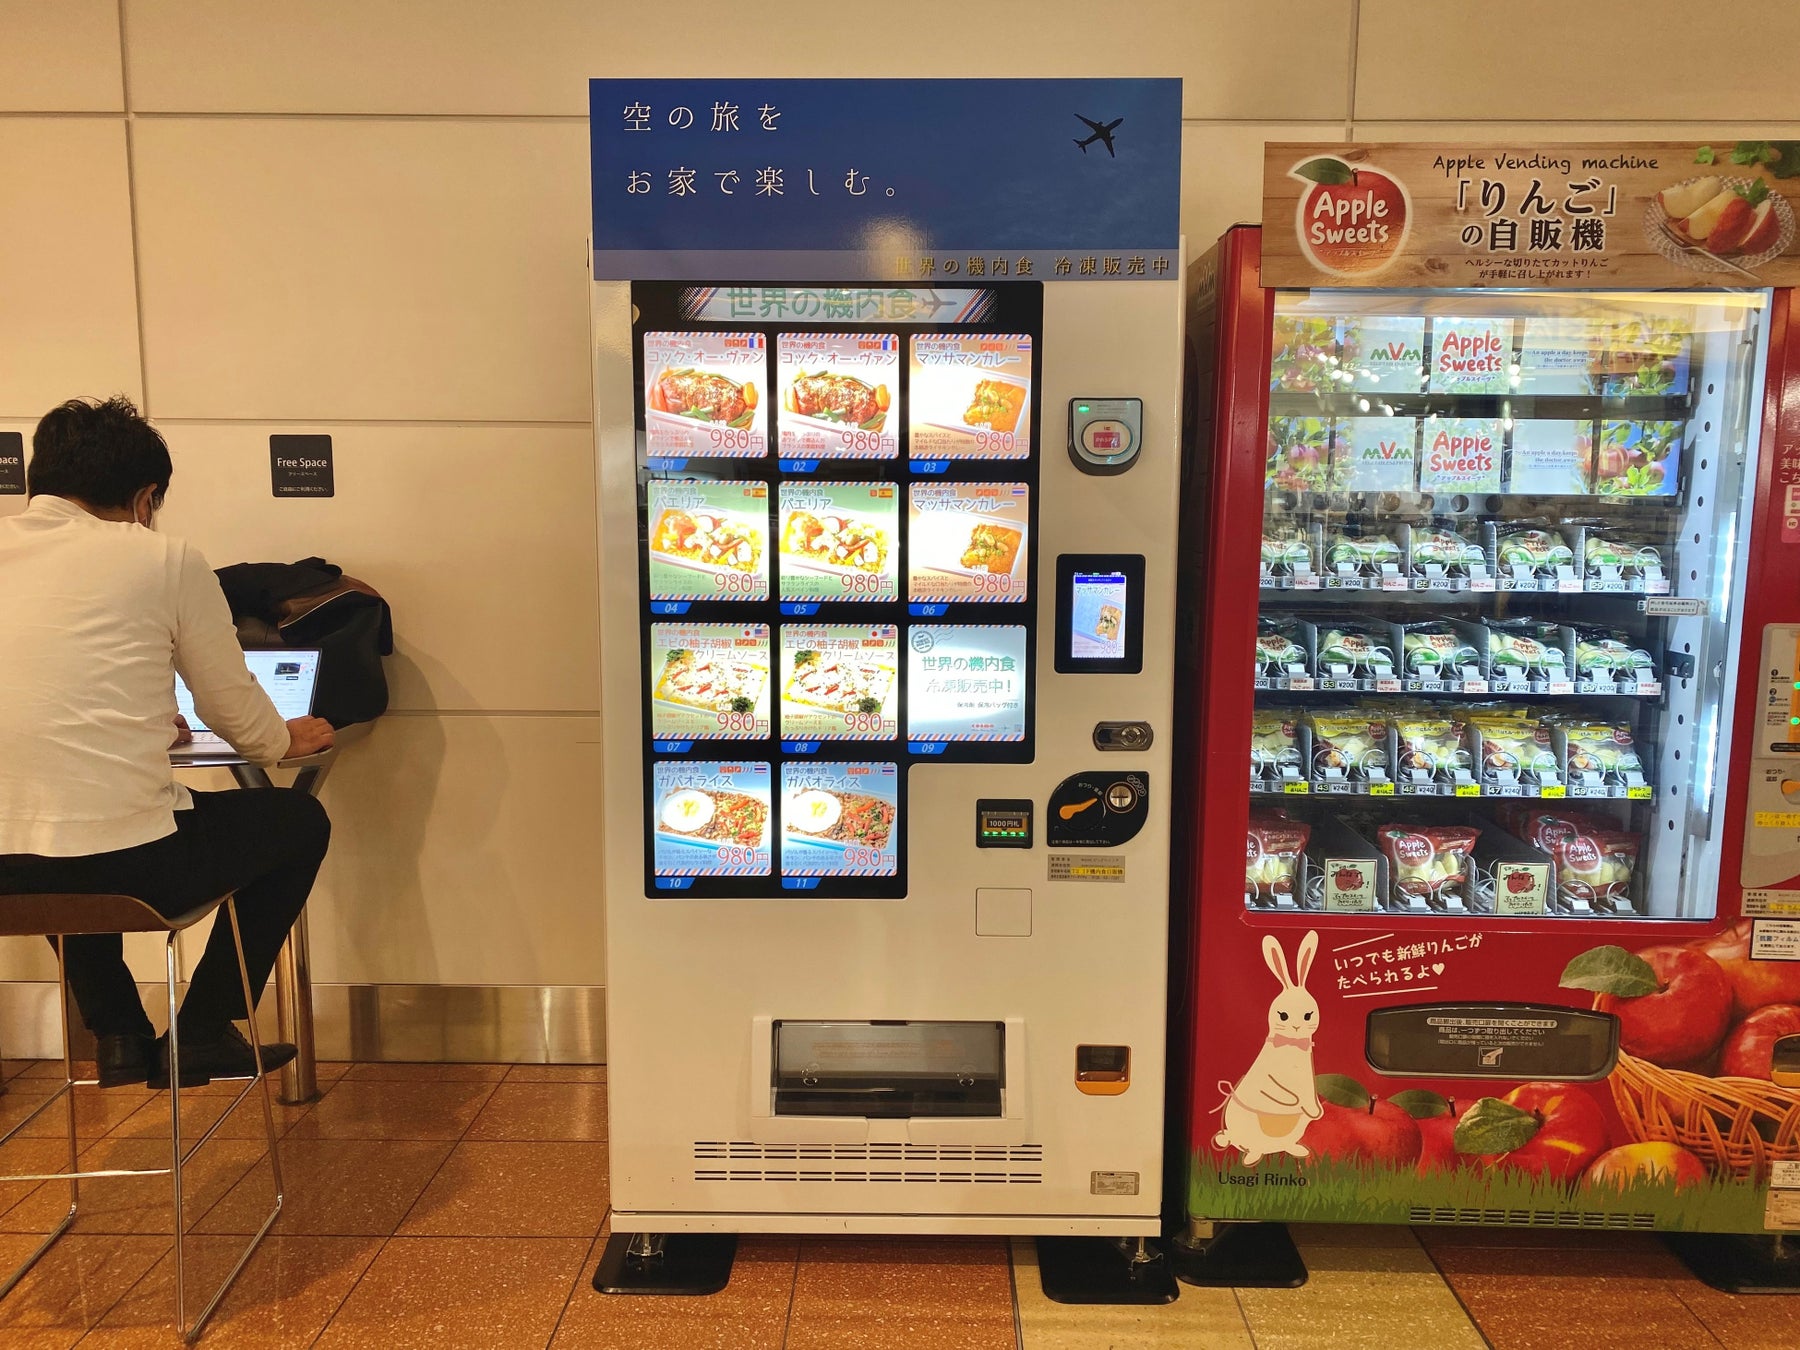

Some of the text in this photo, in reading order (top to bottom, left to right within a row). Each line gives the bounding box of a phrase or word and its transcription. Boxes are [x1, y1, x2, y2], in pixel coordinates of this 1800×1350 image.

[622, 101, 782, 133] 空の旅を
[1433, 153, 1659, 178] Apple Vending machine
[626, 166, 896, 197] お家で楽しむ。
[1458, 178, 1616, 217] 「りんご」
[1313, 190, 1389, 226] Apple
[1311, 220, 1389, 245] Sweets
[1461, 218, 1604, 251] の自販機
[896, 255, 1170, 277] 世界の機内食 冷凍販売中
[1465, 257, 1609, 268] ヘルシーな切りたてカットりんご
[1479, 269, 1591, 280] が手軽に召し上がれます！
[727, 288, 919, 319] 世界の機内食
[1442, 330, 1502, 357] Apple
[917, 353, 1020, 365] マッサマンカレー
[1440, 354, 1502, 373] Sweets
[1449, 375, 1495, 383] ップルスイーツ
[710, 429, 764, 450] 980円
[842, 431, 895, 452] 980円
[976, 432, 1029, 453] 980円
[1432, 431, 1492, 457] Apple
[277, 457, 328, 469] Free Space
[662, 460, 674, 470] 01
[793, 463, 806, 472] 02
[923, 463, 936, 472] 03
[1430, 453, 1492, 472] Sweets
[654, 496, 704, 509] パエリア
[781, 498, 832, 510] パエリア
[914, 498, 1015, 511] マッサマンカレー
[715, 574, 767, 594] 980円
[841, 574, 894, 594] 980円
[973, 574, 1025, 594] 980円
[1344, 579, 1361, 587] ¥200
[1432, 580, 1449, 588] ¥200
[665, 604, 678, 613] 04
[794, 604, 807, 614] 05
[922, 605, 936, 615] 06
[695, 650, 768, 660] クリームソース
[823, 651, 895, 661] クリームソース
[922, 656, 1017, 672] 世界の機内食
[1338, 681, 1354, 689] ¥200
[1425, 682, 1441, 690] ¥200
[1512, 683, 1530, 691] ¥200
[717, 712, 768, 733] 980円
[844, 713, 896, 734] 980円
[667, 742, 681, 752] 07
[794, 743, 808, 752] 08
[922, 744, 935, 753] 09
[659, 775, 733, 787] ガパオライス
[787, 776, 861, 788] ガパオライス
[1250, 783, 1263, 791] 240
[1317, 784, 1349, 793] 43 ¥240
[1419, 786, 1435, 794] ¥240
[1489, 786, 1501, 795] 47
[1574, 788, 1587, 796] 49
[1399, 840, 1426, 851] Apple
[1570, 843, 1592, 855] Apple
[717, 847, 769, 866] 980円
[844, 848, 896, 868] 980円
[1400, 849, 1429, 859] Sweets
[1569, 853, 1597, 862] Sweets
[669, 878, 681, 888] 10
[797, 878, 807, 888] 11
[1334, 932, 1483, 971] いつでも新鮮りんごが
[1218, 1172, 1307, 1187] Usagi Rinko
